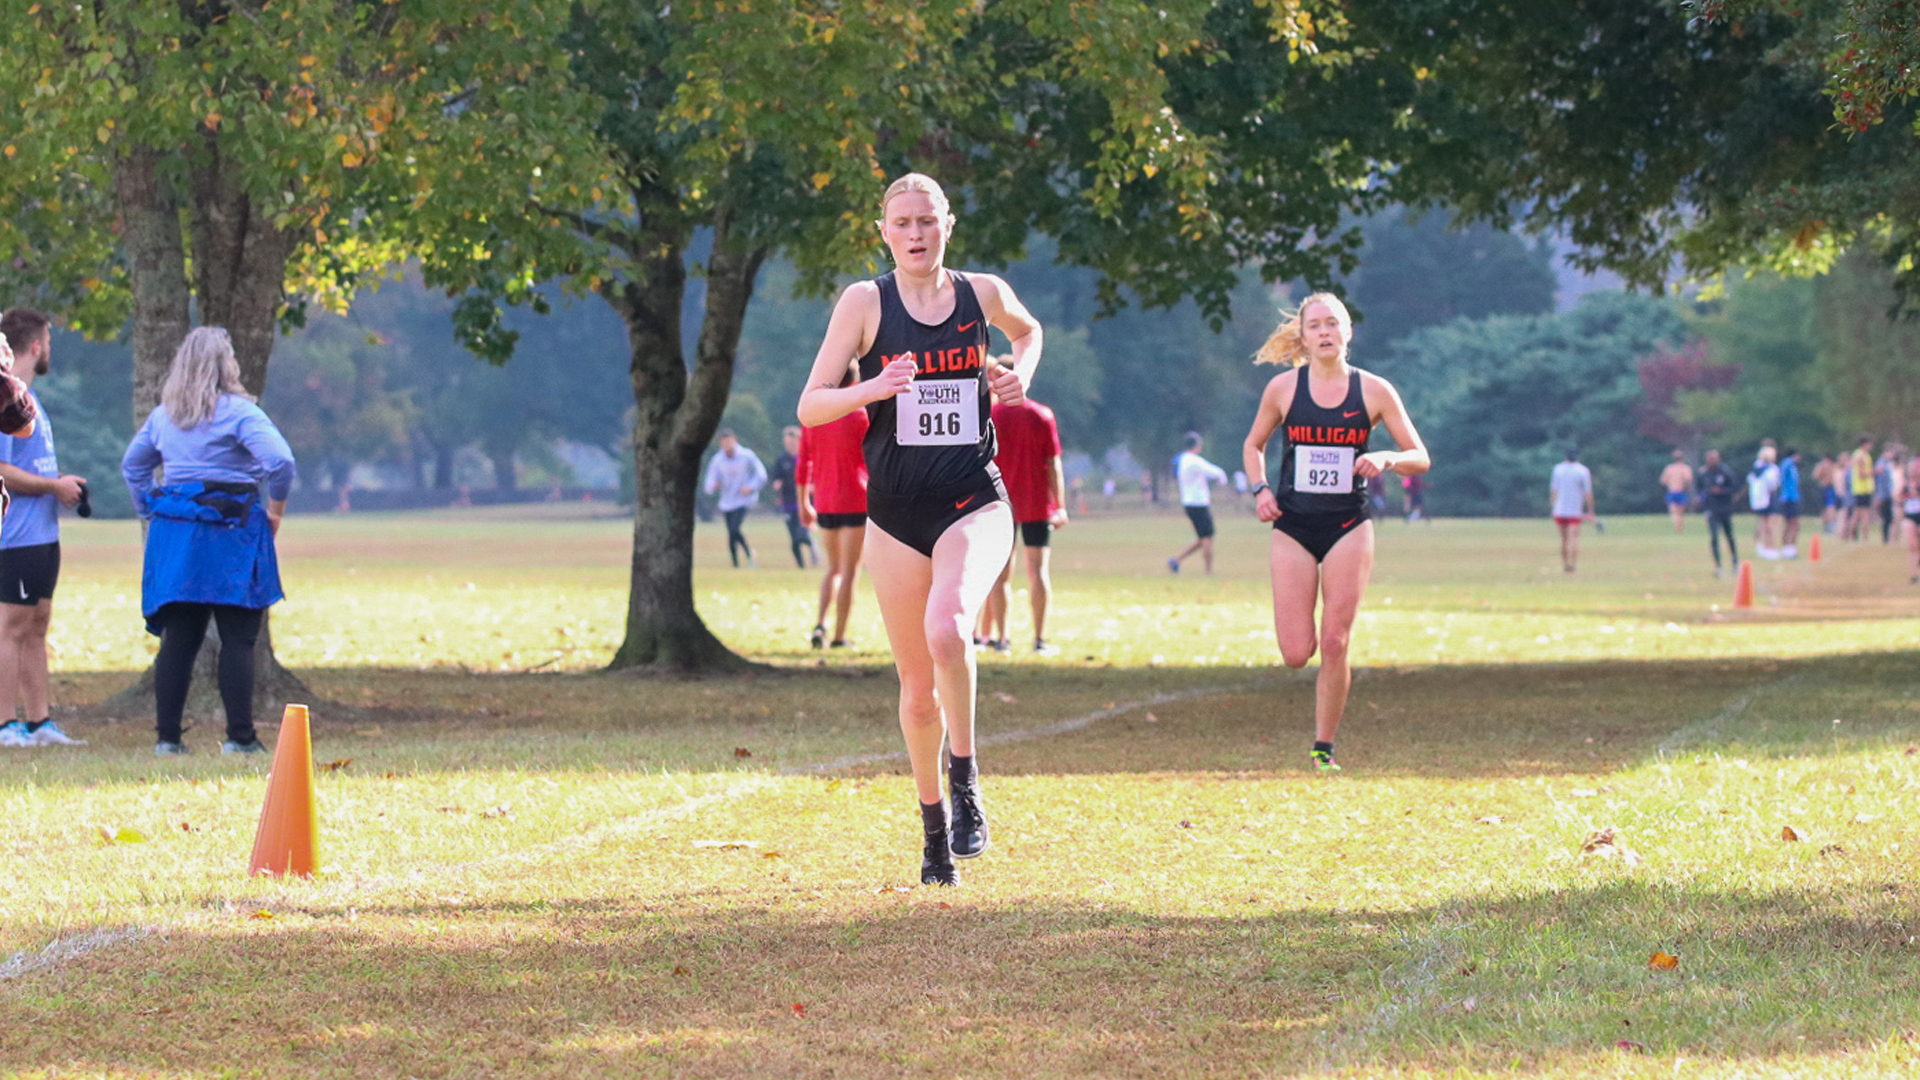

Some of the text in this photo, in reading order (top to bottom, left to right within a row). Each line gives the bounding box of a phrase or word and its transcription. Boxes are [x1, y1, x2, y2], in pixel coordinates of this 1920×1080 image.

[881, 344, 985, 374] MLLIGAN
[919, 388, 960, 399] YOUTH
[919, 412, 960, 436] 916
[1288, 426, 1367, 444] MILLIGAN
[1309, 469, 1338, 486] 923
